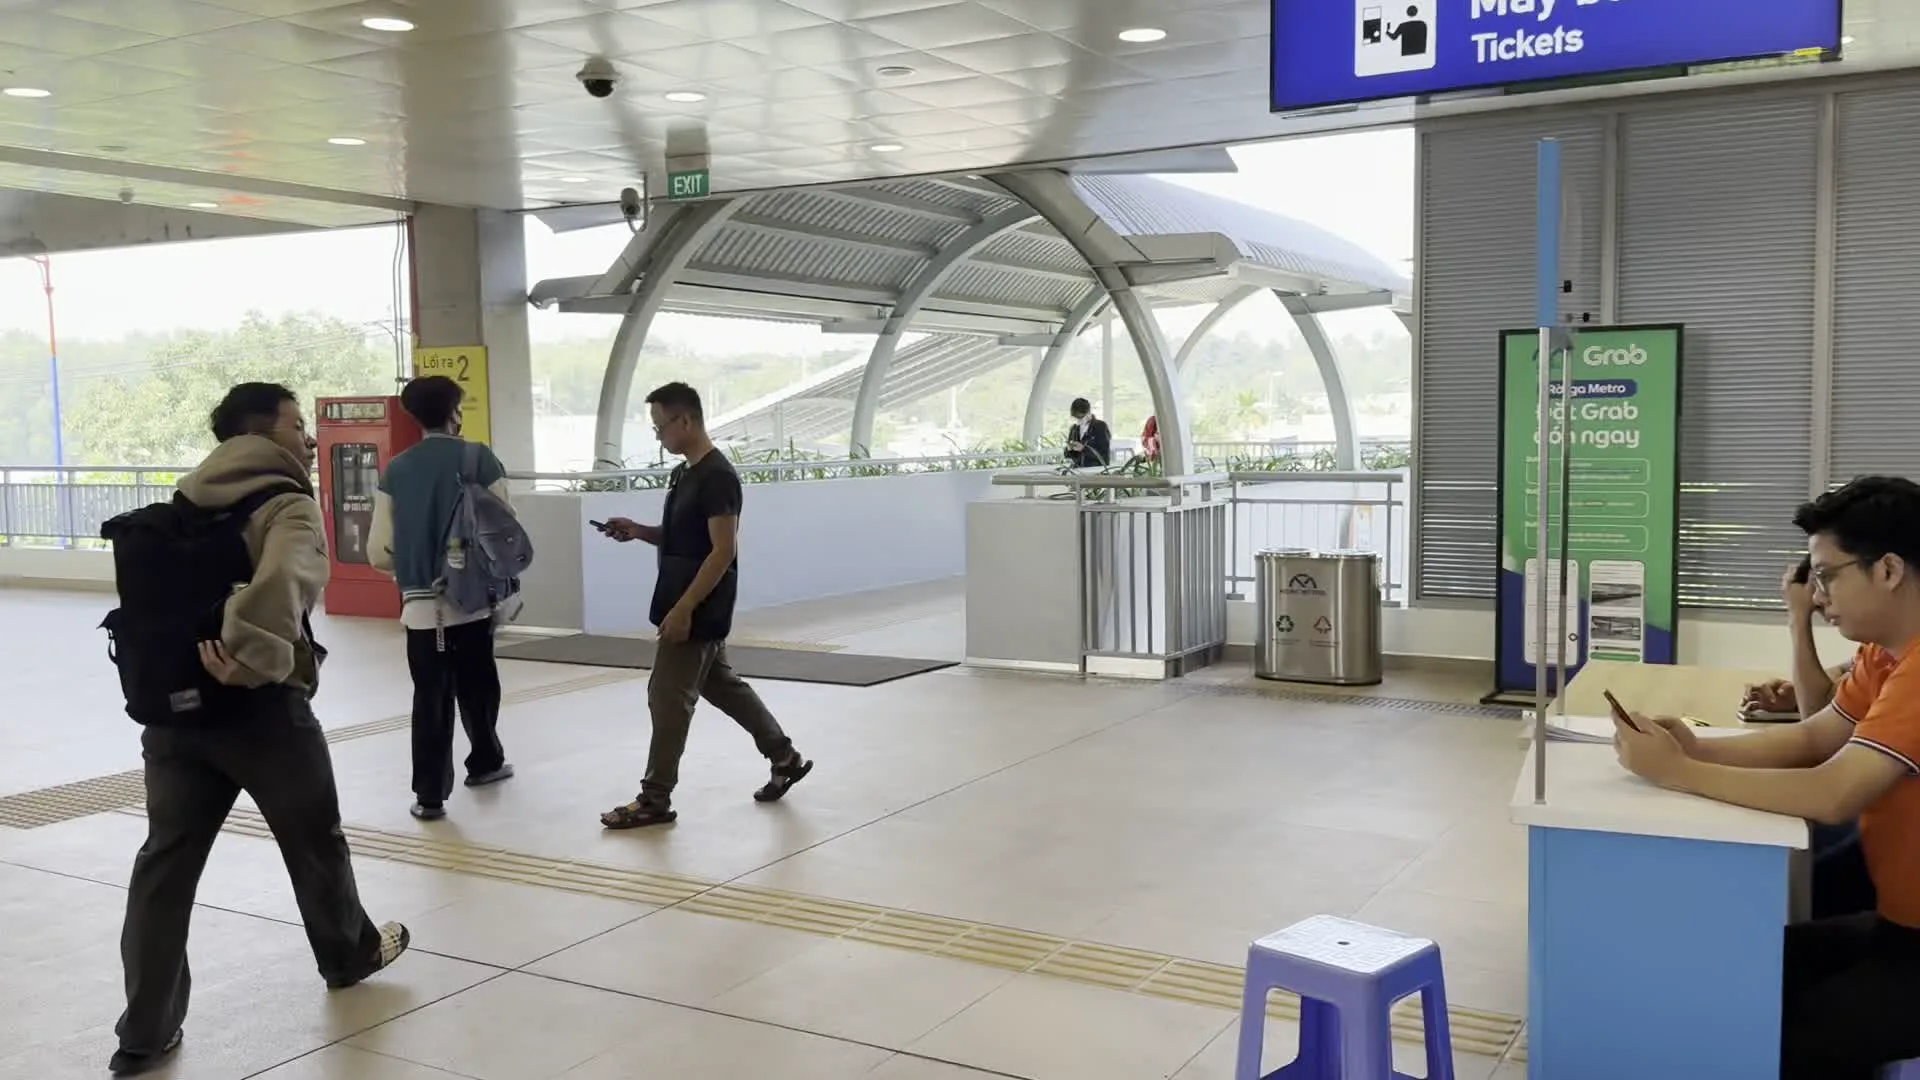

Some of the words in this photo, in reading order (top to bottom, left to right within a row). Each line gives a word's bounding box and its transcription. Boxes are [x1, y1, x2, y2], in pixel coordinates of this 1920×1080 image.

[1471, 25, 1584, 63] Tickets
[674, 174, 704, 195] EXIT
[1583, 343, 1648, 366] Grab
[457, 354, 470, 381] 2
[1588, 383, 1627, 394] Metro
[1581, 401, 1639, 420] Grab
[1581, 429, 1641, 449] ngay
